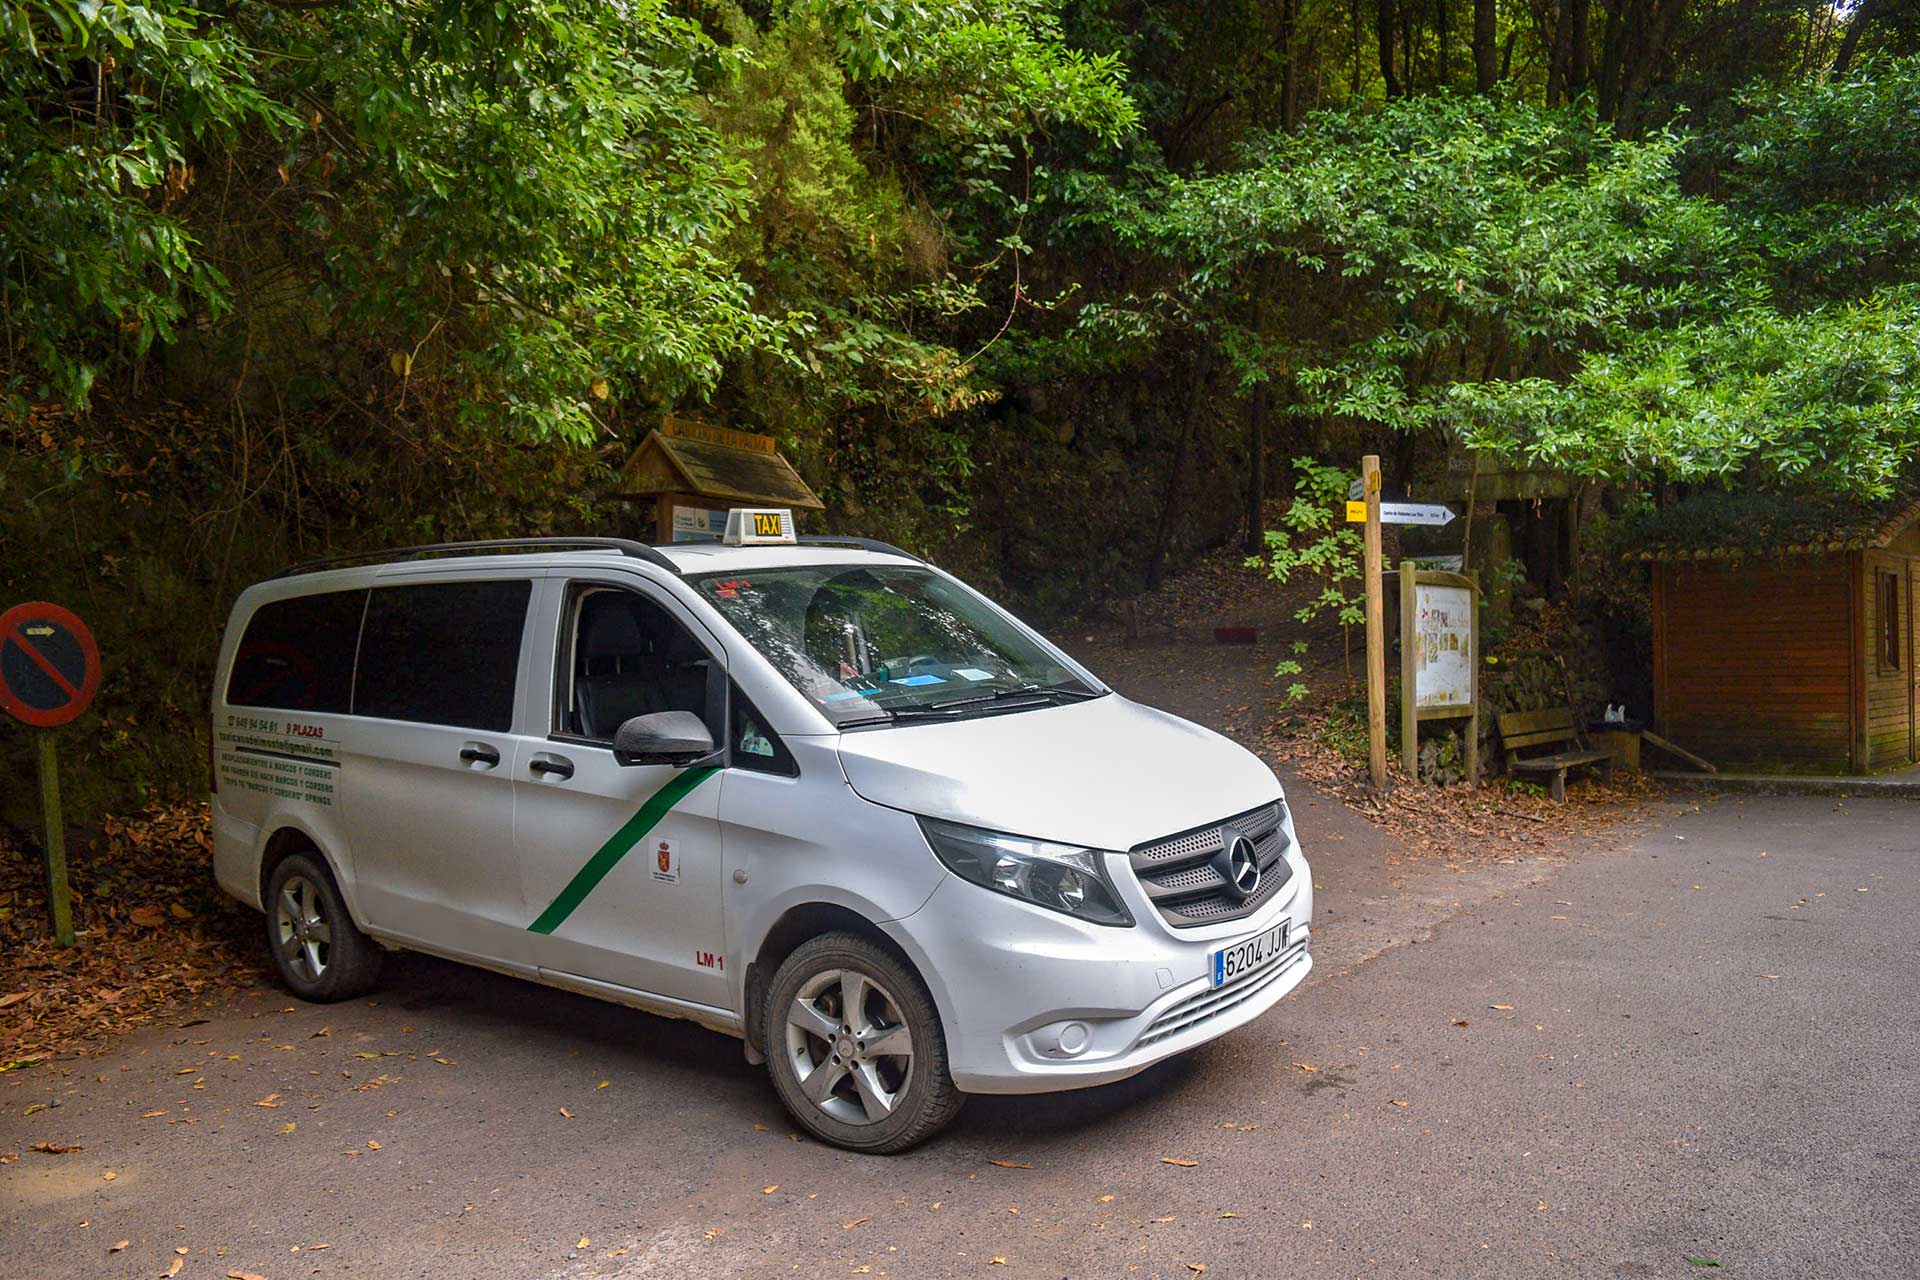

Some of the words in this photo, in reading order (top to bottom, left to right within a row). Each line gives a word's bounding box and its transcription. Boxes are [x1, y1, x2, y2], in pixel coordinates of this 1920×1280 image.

[754, 514, 781, 535] TAXI
[286, 722, 293, 734] 9
[293, 723, 324, 738] PLAZAS
[275, 773, 298, 787] MARCOS
[299, 777, 304, 787] Y
[305, 778, 333, 793] CORDERO
[304, 766, 332, 780] CORDERO
[696, 951, 714, 969] LM
[717, 955, 724, 971] 1
[1226, 938, 1263, 977] 6204
